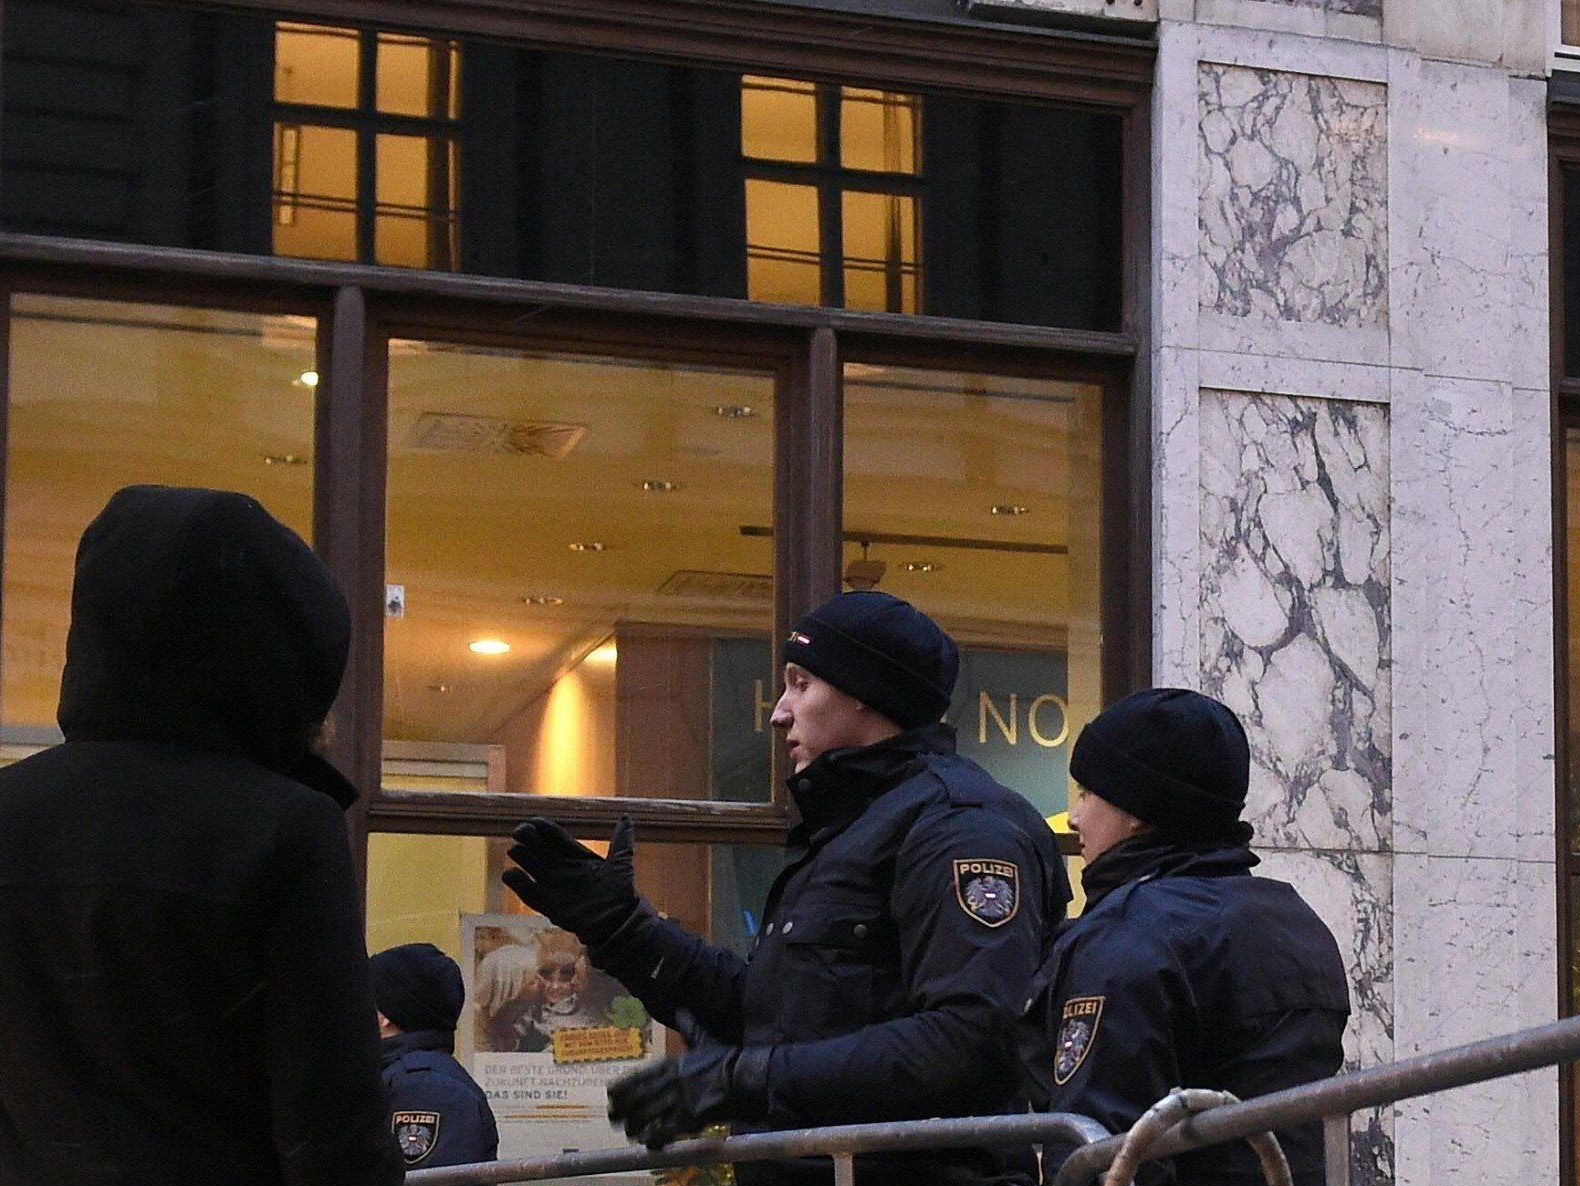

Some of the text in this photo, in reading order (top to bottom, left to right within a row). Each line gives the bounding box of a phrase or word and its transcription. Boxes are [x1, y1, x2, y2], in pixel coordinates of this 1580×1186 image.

[959, 863, 1014, 878] POLIZEI
[510, 1065, 543, 1075] BESTE
[486, 1090, 568, 1100] DAS SIND SIE!
[395, 1114, 435, 1124] POLIZEI
